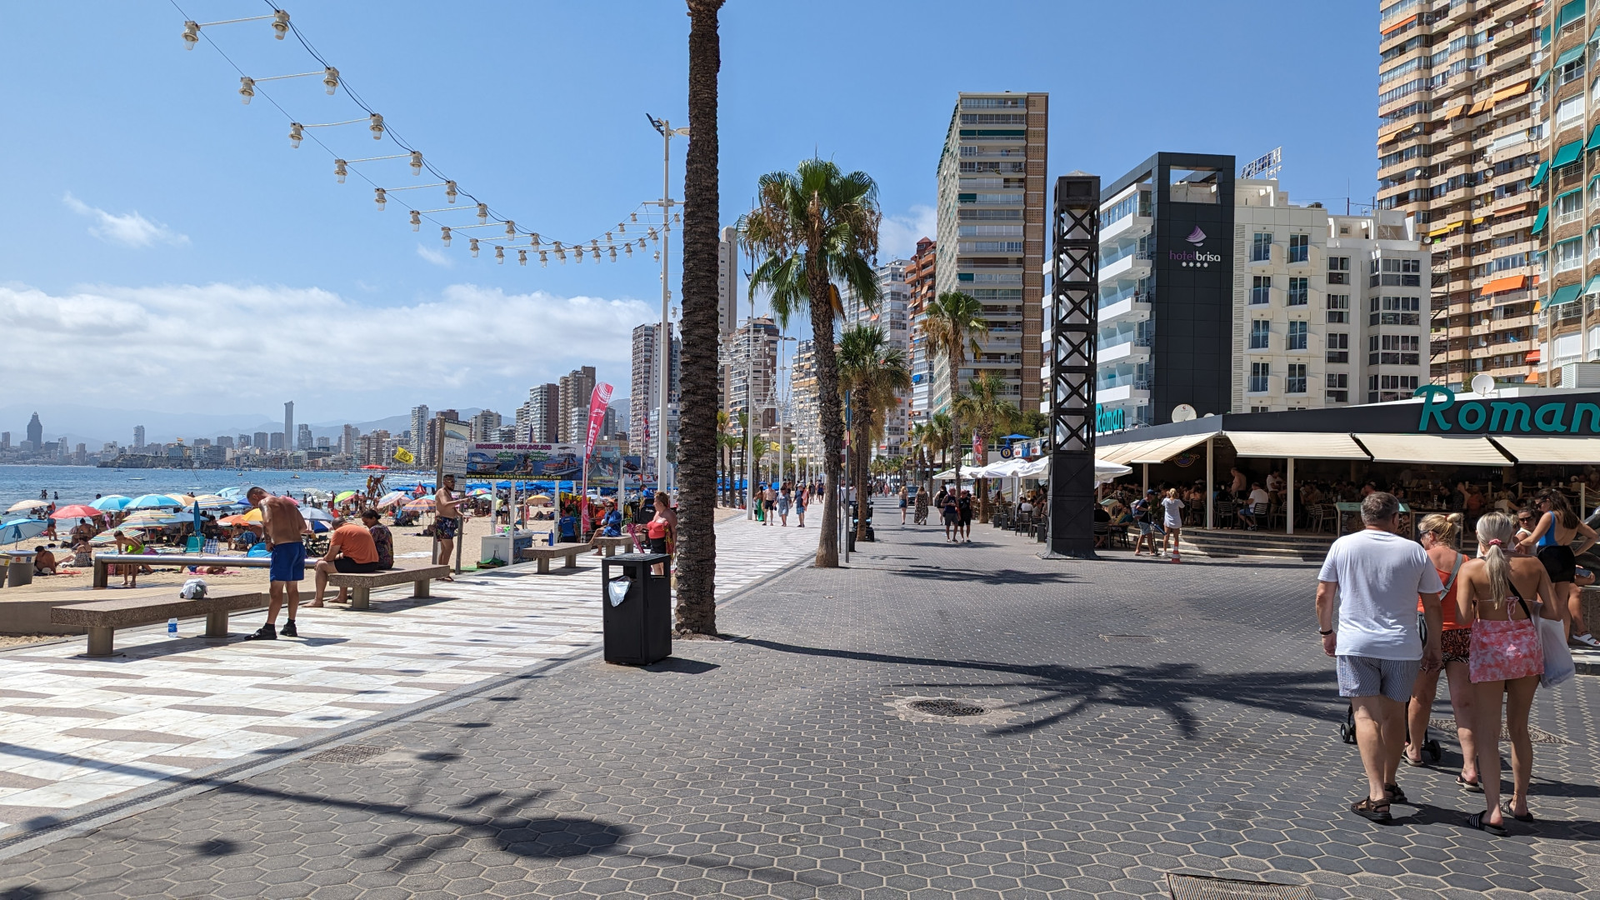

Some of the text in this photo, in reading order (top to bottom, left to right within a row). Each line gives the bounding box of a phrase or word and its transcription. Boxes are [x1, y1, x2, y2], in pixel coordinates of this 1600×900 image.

[1169, 249, 1220, 262] hotelbrisa
[1096, 403, 1125, 433] Roman
[1413, 384, 1600, 433] Roman
